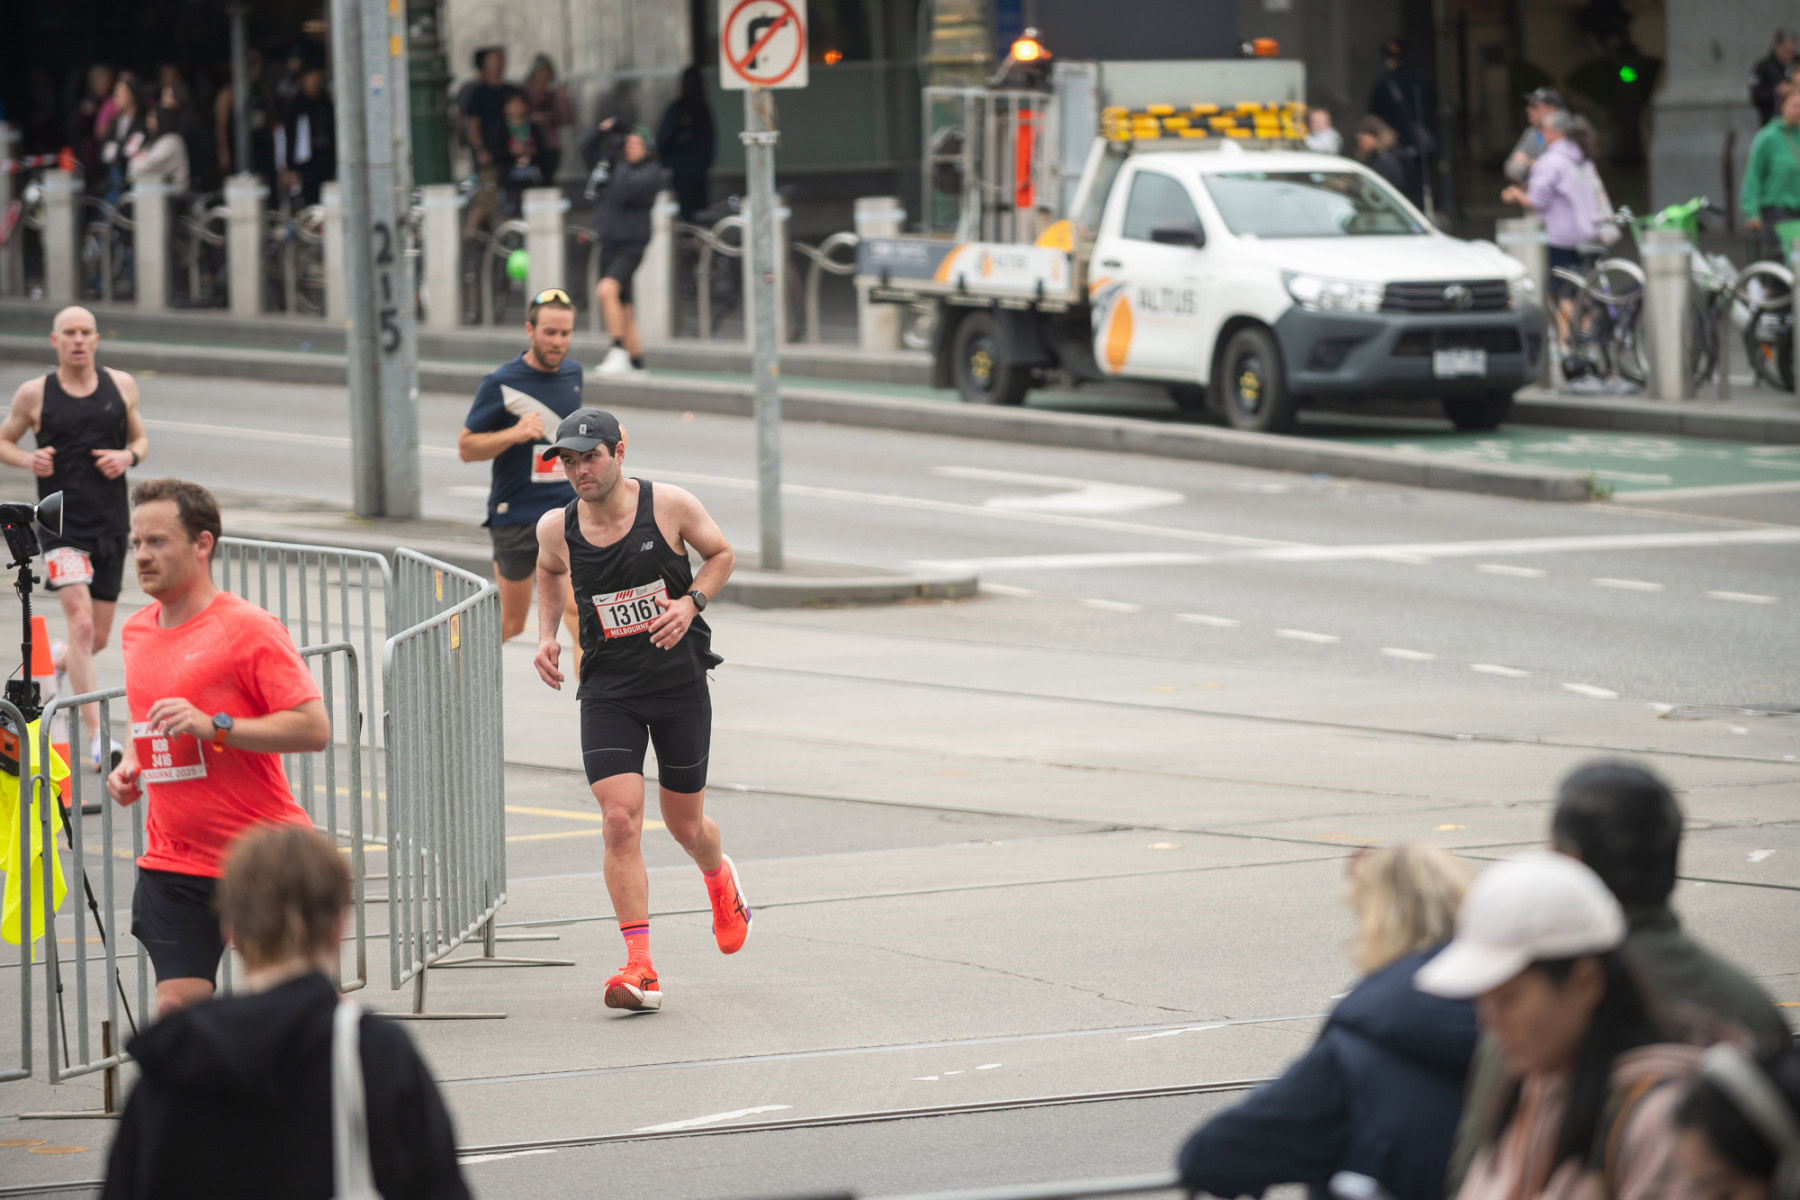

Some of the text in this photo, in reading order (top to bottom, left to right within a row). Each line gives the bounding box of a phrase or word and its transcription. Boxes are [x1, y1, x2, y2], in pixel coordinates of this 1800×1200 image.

[374, 222, 401, 354] 215
[609, 595, 661, 627] 13161
[610, 622, 650, 637] MELBOURNE
[152, 738, 169, 753] ROB
[152, 753, 172, 768] 3416
